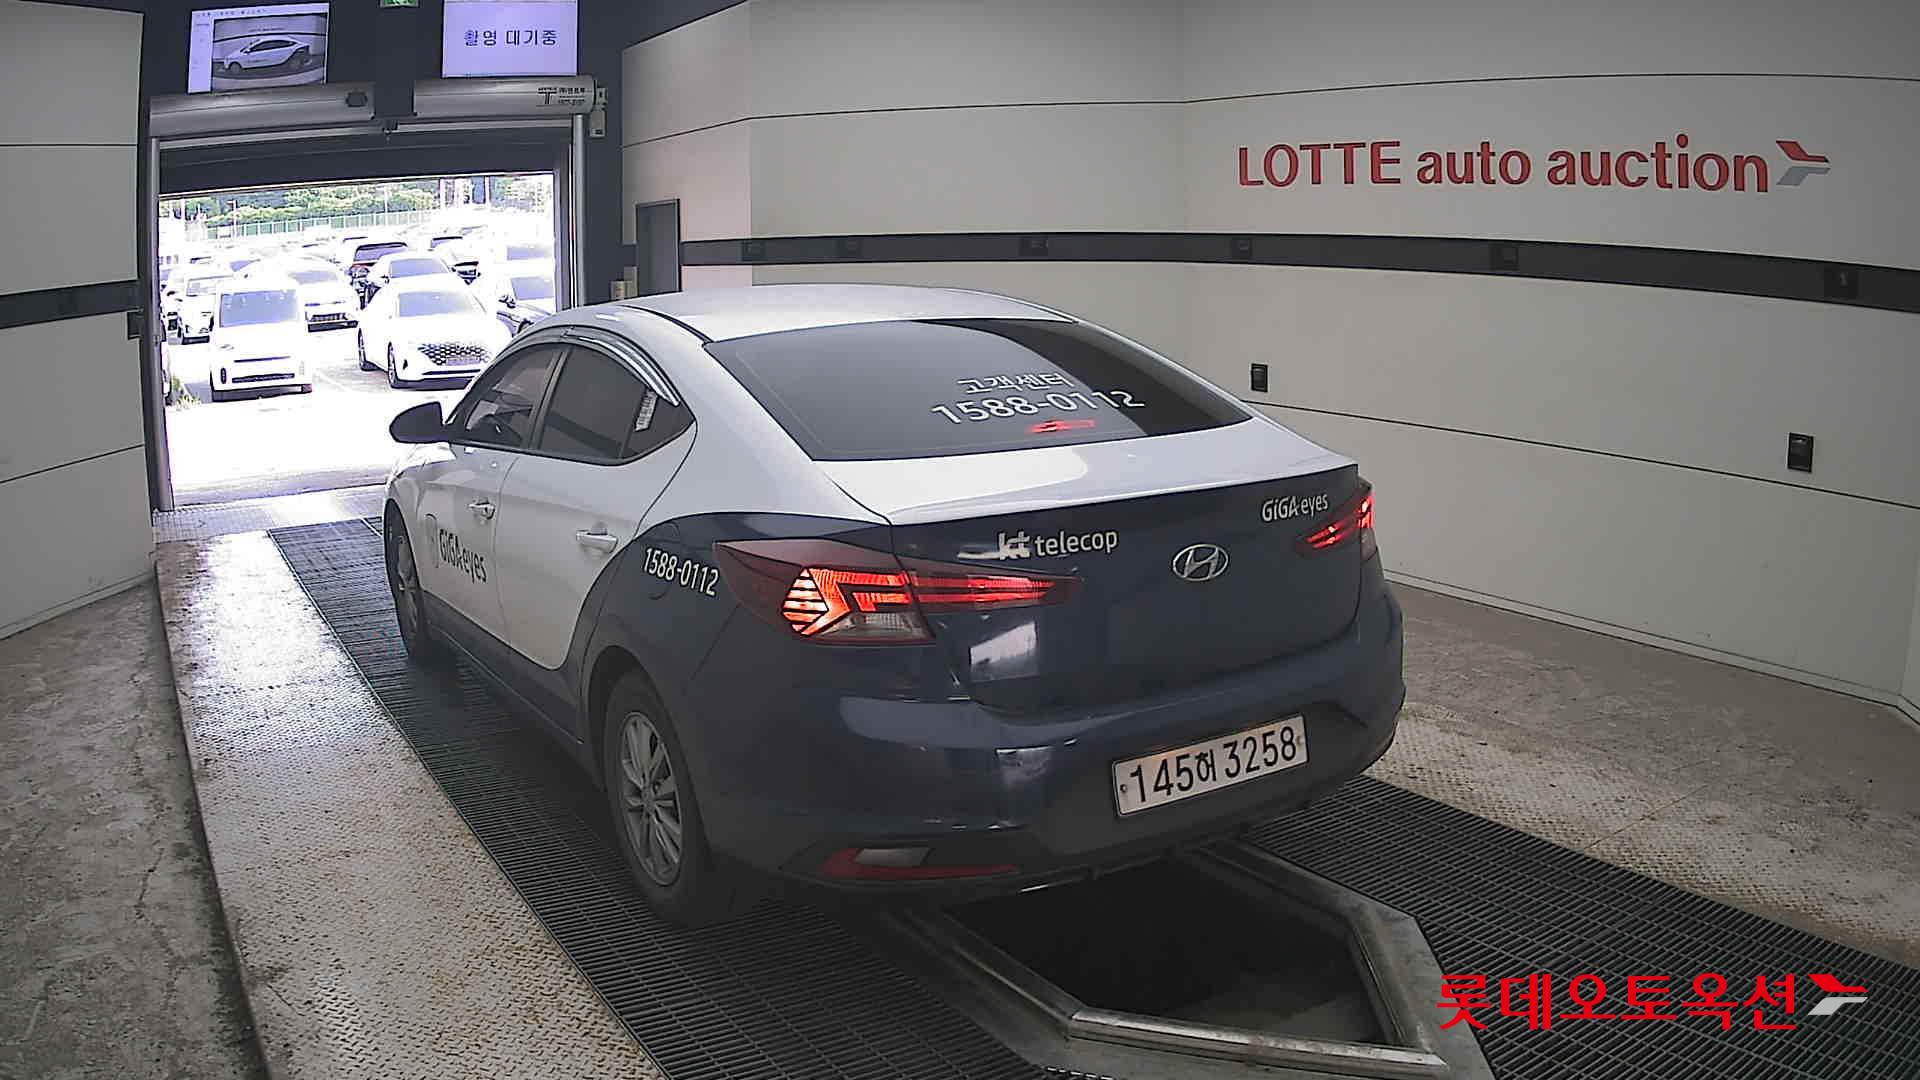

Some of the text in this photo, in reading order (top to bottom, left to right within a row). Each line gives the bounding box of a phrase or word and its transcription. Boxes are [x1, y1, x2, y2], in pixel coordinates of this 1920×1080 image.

[505, 29, 558, 46] 대기중
[1239, 134, 1769, 193] LOTTE auto auction
[957, 372, 1075, 393] 고객센터
[931, 391, 1145, 424] 1588-0112
[1034, 530, 1119, 557] telecop
[643, 547, 720, 598] 1588-0112
[1223, 726, 1297, 778] 3258
